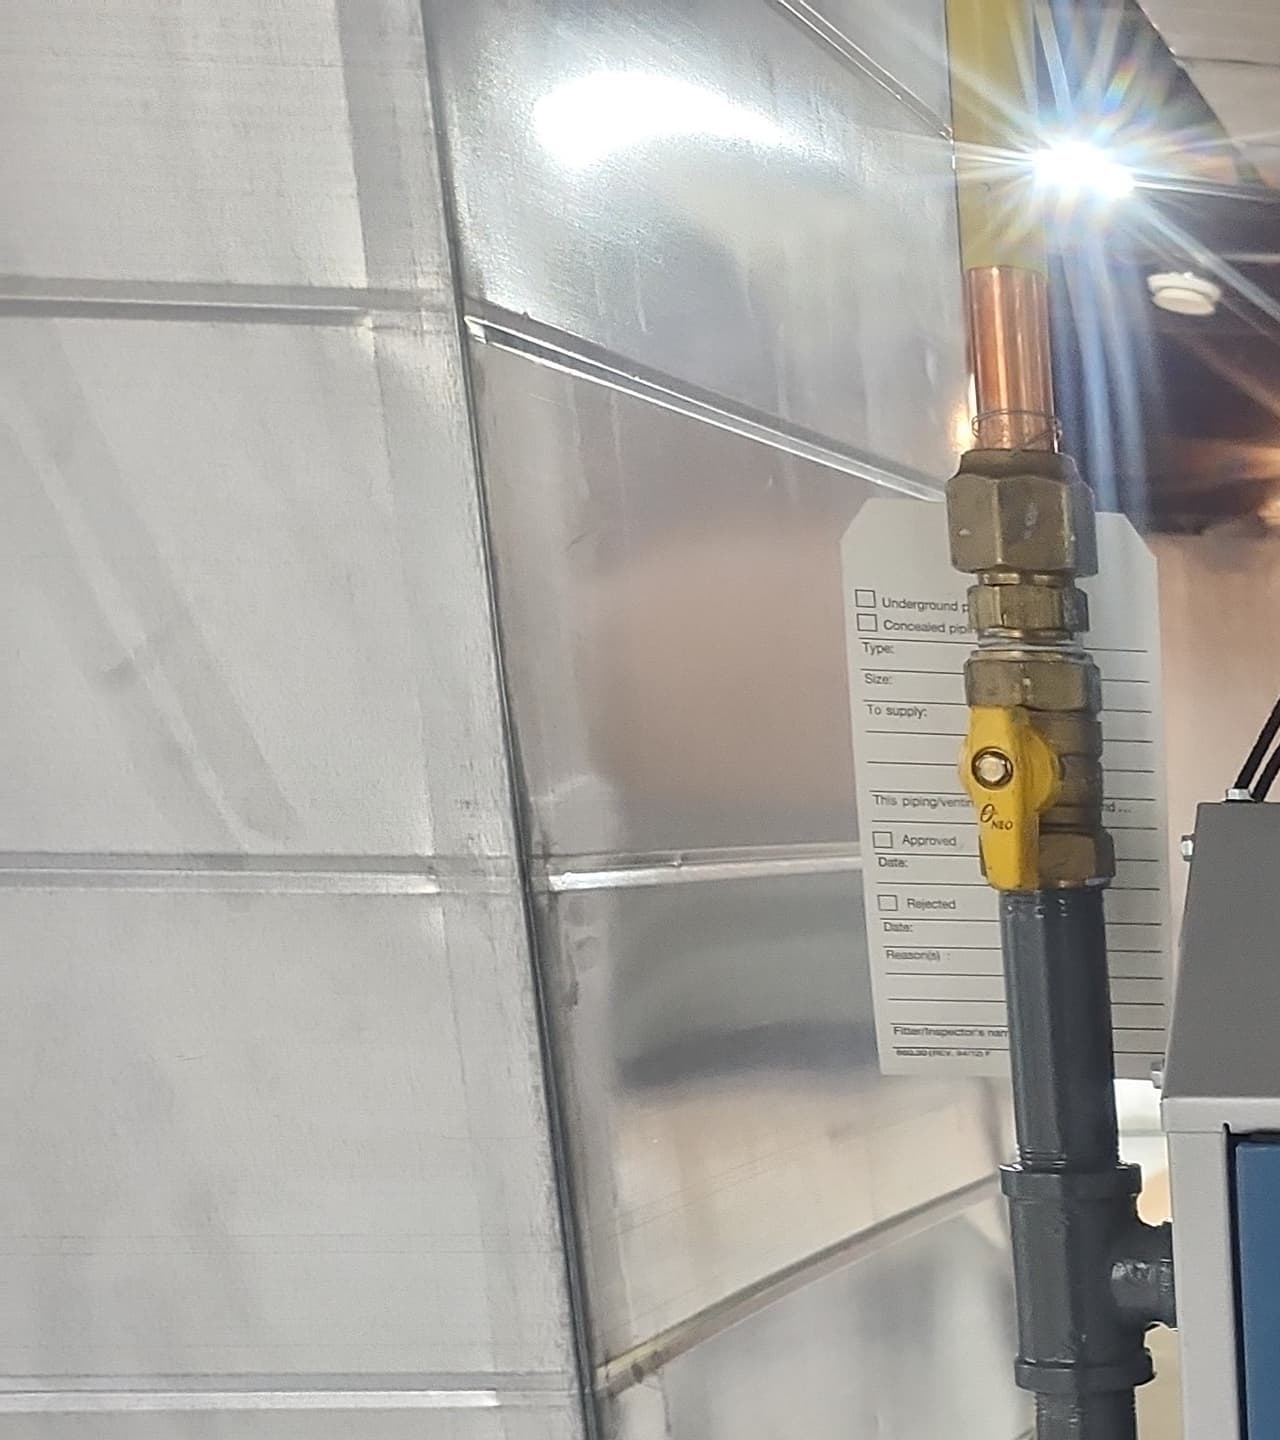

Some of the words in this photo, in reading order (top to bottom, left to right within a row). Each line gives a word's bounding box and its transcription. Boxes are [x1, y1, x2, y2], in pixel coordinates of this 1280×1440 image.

[882, 597, 958, 612] Underground
[883, 619, 946, 633] Concealed
[862, 641, 895, 656] Type:
[864, 673, 893, 685] Size:
[867, 704, 882, 716] To
[886, 706, 928, 719] supply:
[873, 794, 897, 806] This
[902, 795, 975, 810] piping/ventin
[902, 834, 957, 847] Approved
[878, 857, 908, 867] Date:
[906, 898, 956, 911] Rejected
[884, 922, 913, 932] Date:
